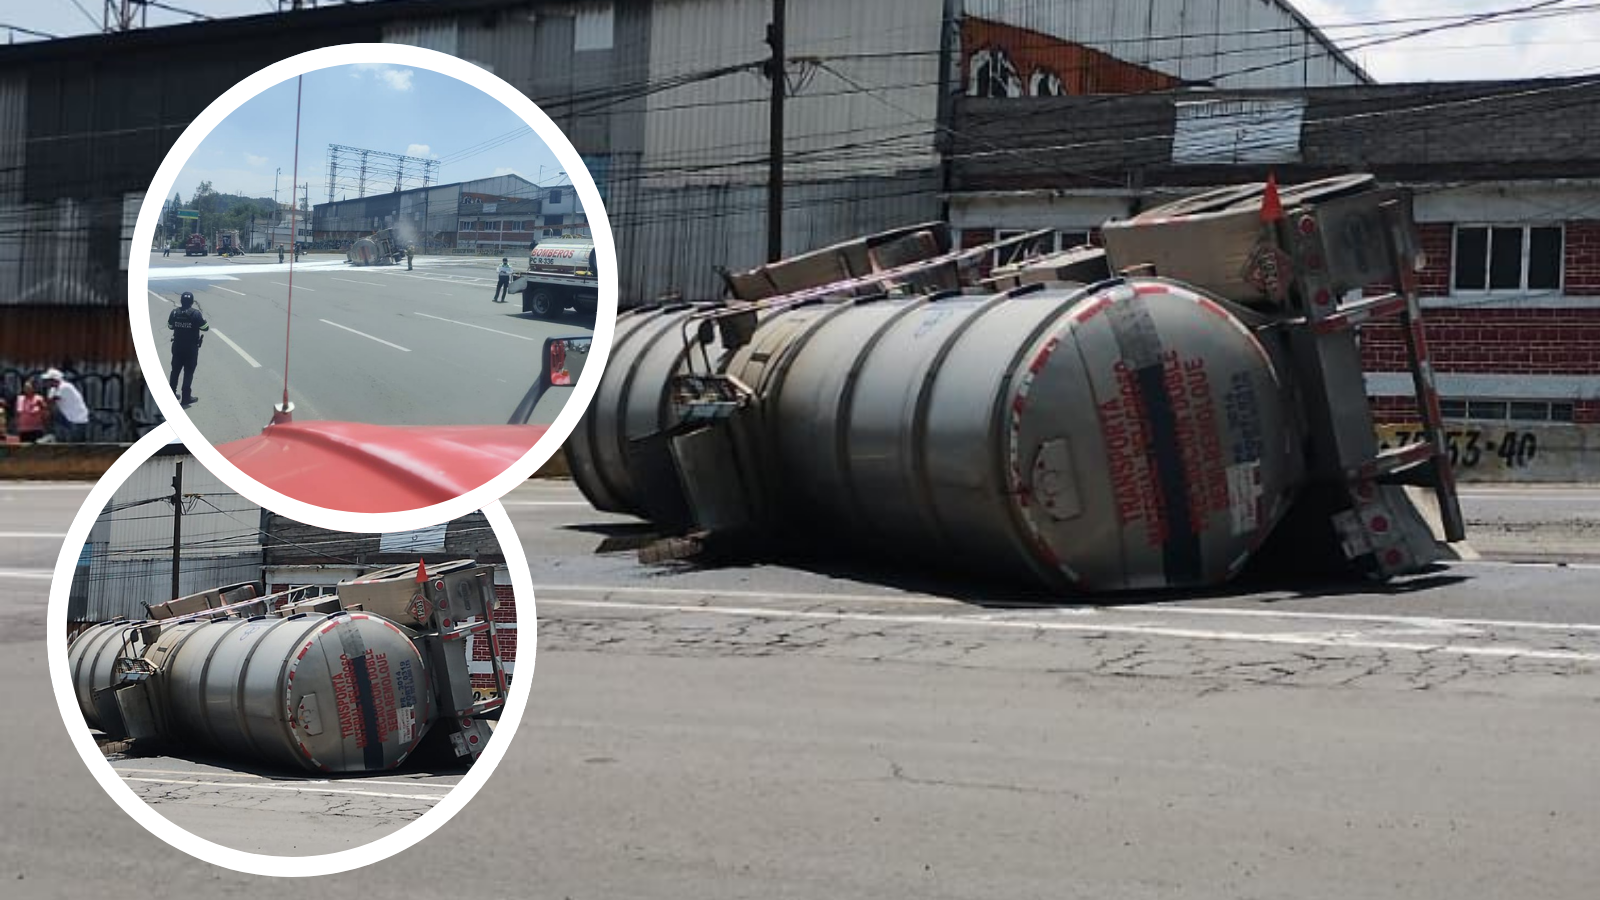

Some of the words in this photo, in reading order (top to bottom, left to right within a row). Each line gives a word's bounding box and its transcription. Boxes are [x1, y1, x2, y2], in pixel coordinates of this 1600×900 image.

[531, 249, 575, 258] BOMBEROS
[1102, 397, 1143, 524] TRANSPORTA
[416, 602, 425, 618] 1203
[340, 654, 360, 704] PELIGROSO
[376, 653, 399, 732] SEMI-REMOLQUE
[332, 673, 355, 739] TRANSPORTA
[351, 704, 368, 749] MATERIAL
